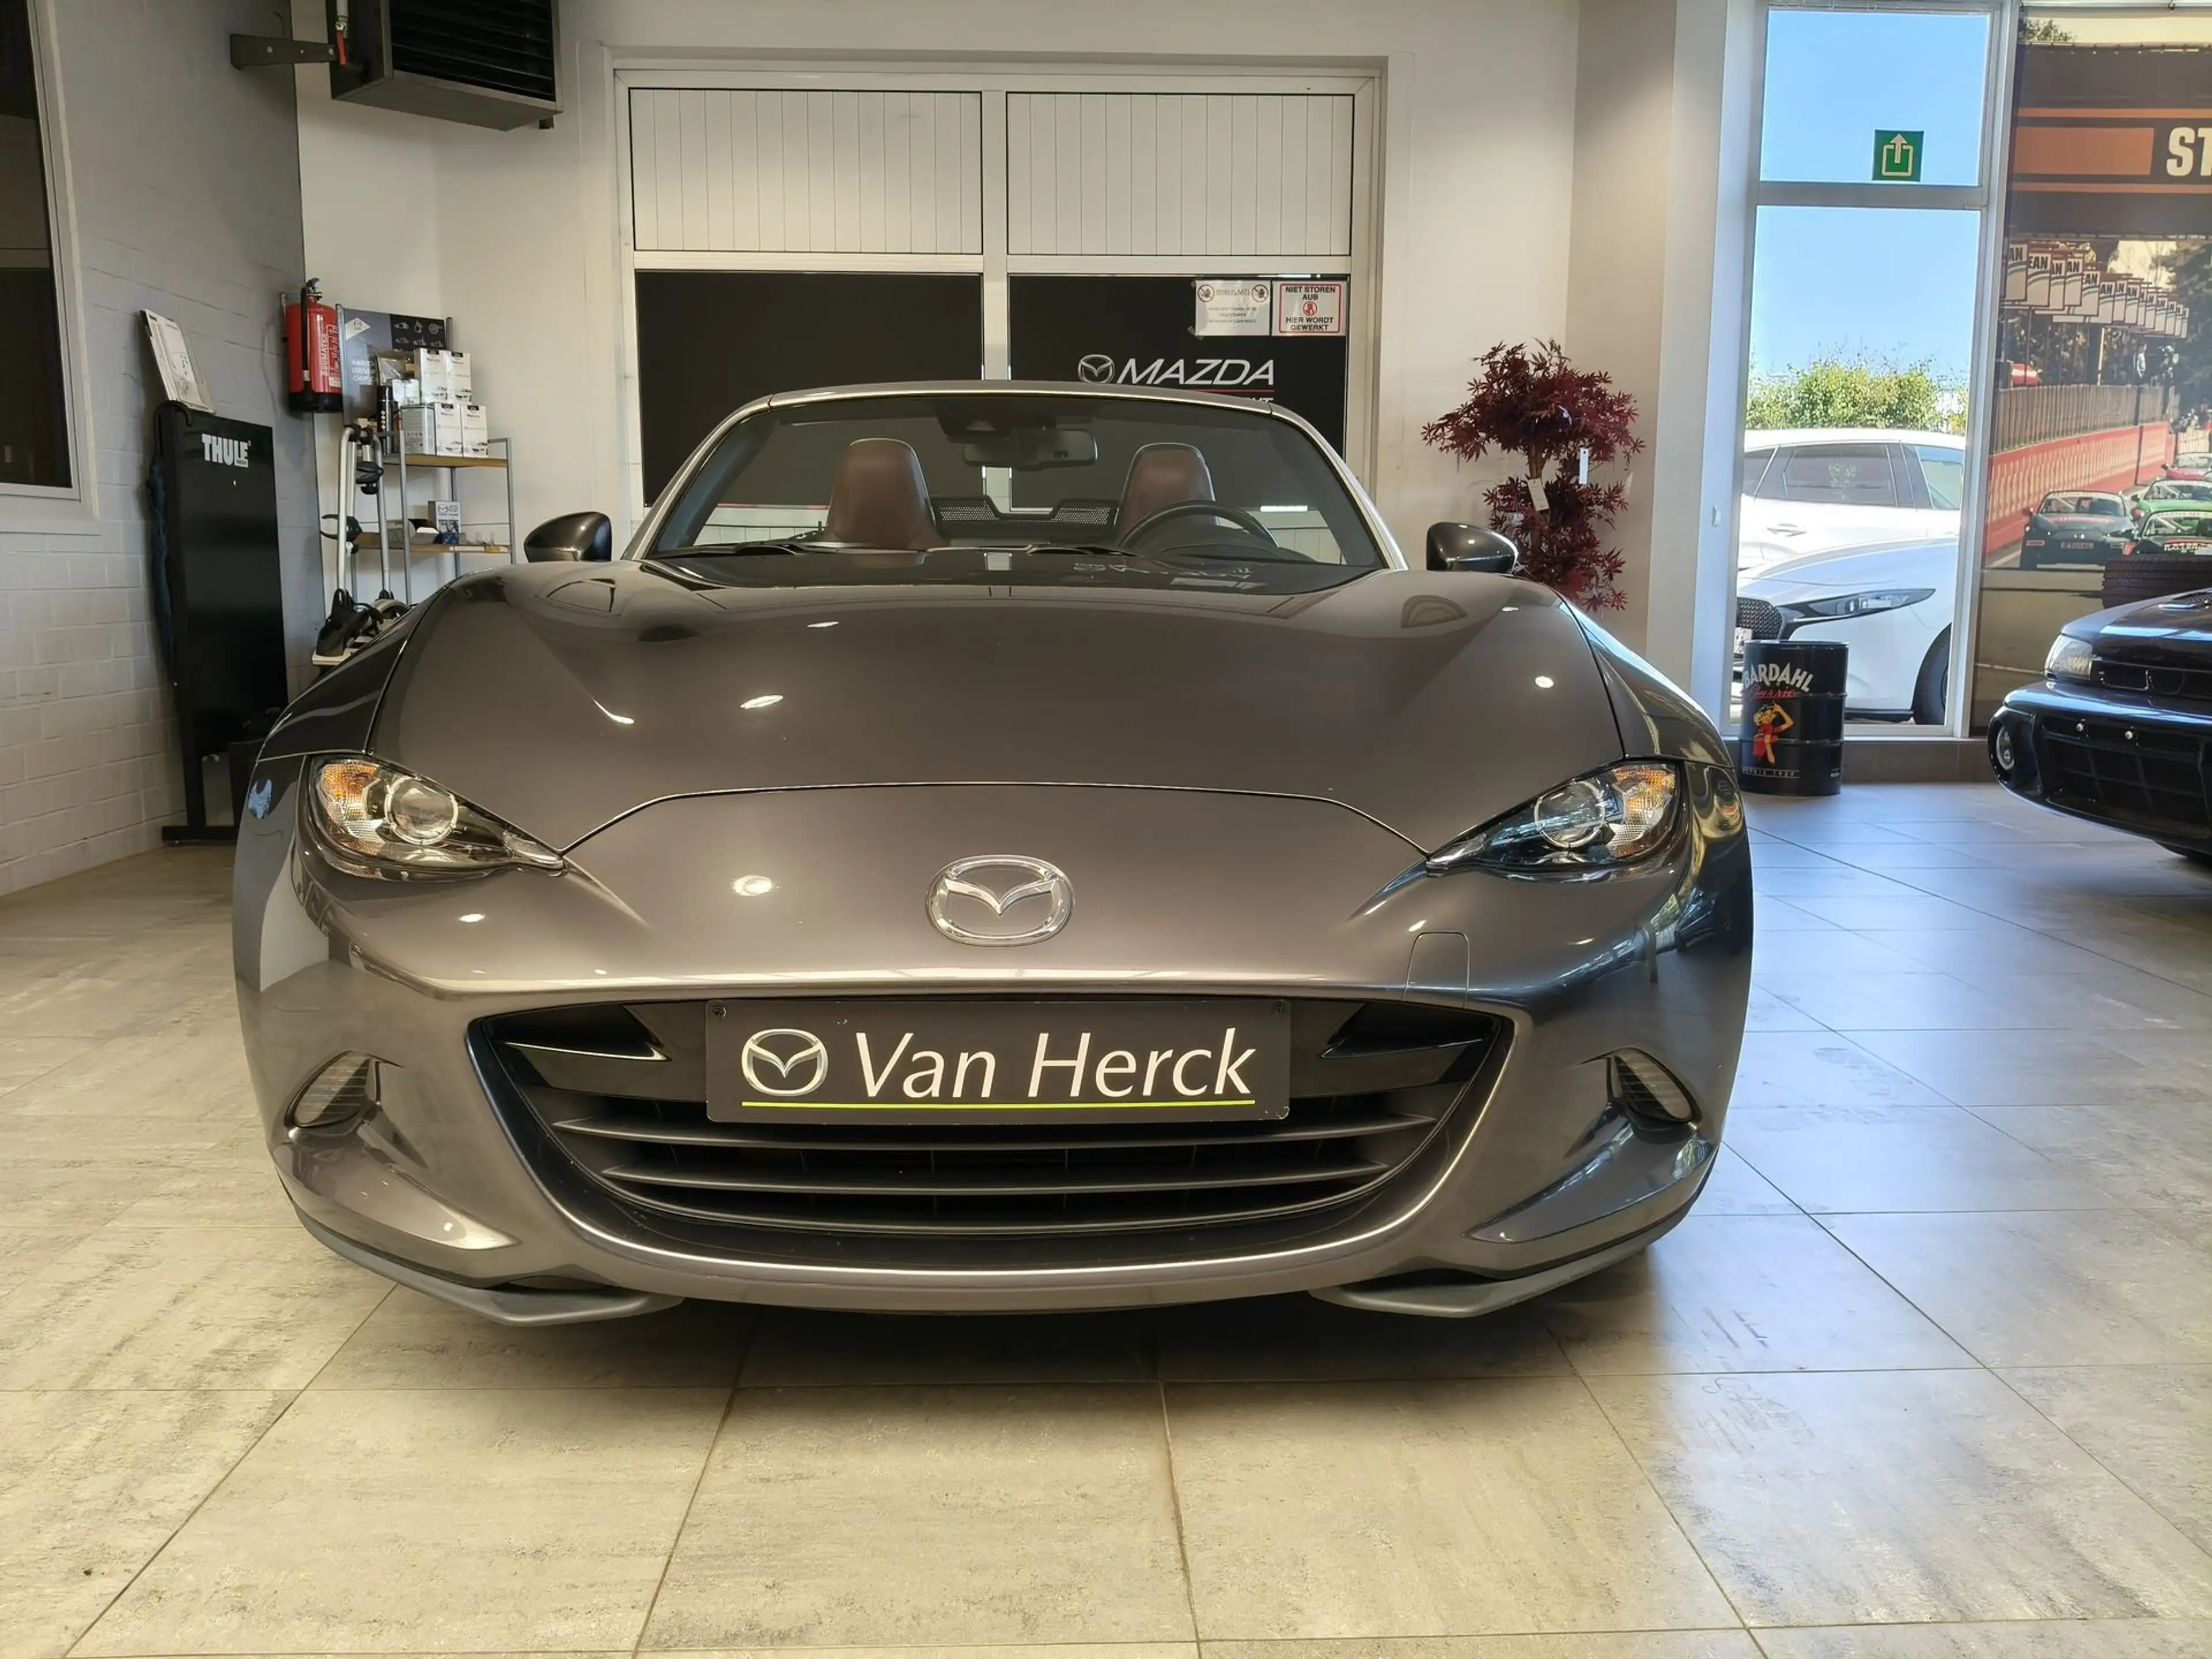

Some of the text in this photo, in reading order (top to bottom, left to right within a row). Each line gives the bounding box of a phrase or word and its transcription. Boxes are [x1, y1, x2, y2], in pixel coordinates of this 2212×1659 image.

[1116, 358, 1275, 385] MAZDA
[201, 433, 249, 468] THULE
[1741, 662, 1814, 692] BARDAHL
[855, 1027, 1256, 1099] Van Herck
